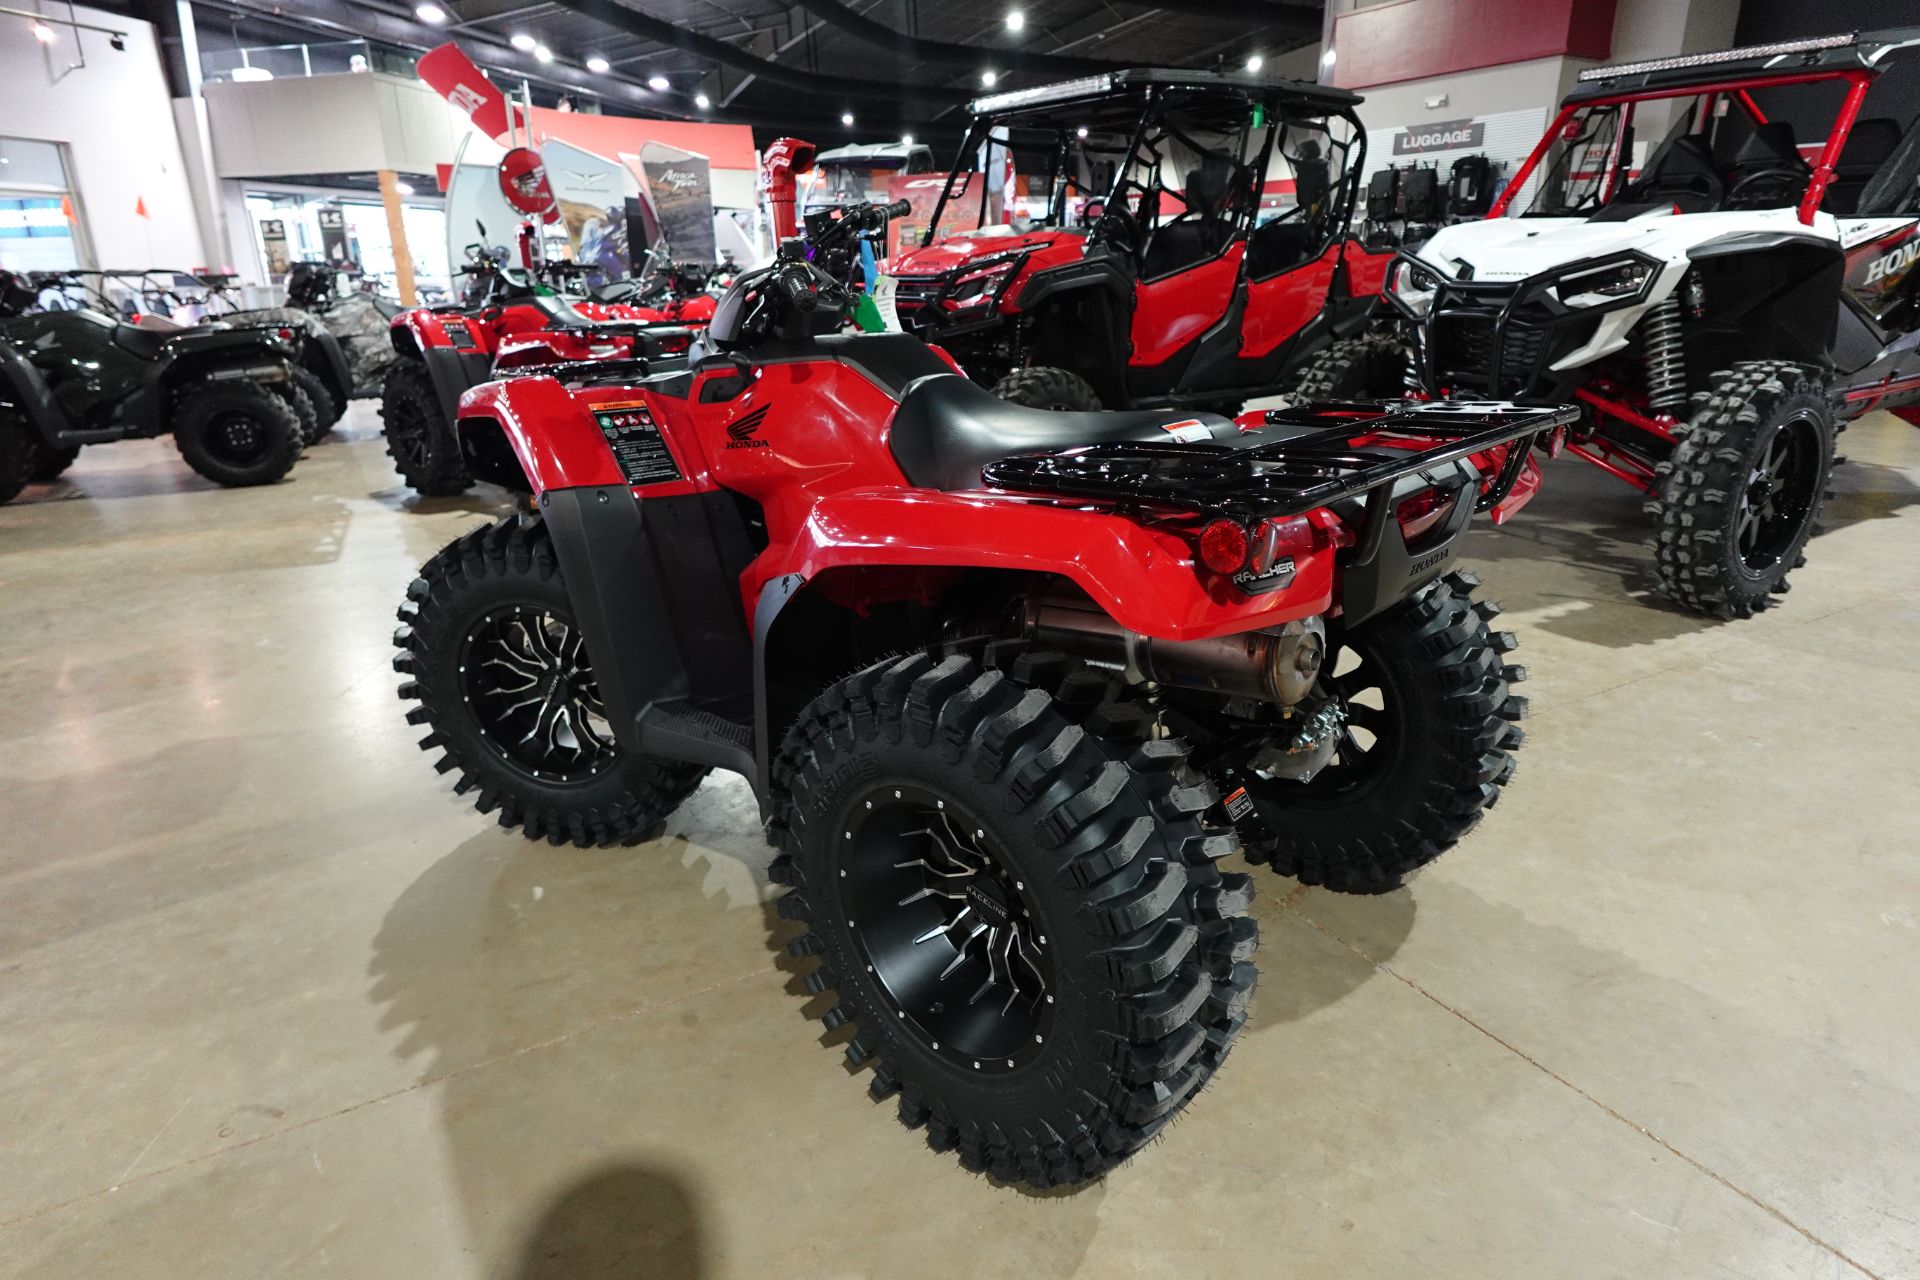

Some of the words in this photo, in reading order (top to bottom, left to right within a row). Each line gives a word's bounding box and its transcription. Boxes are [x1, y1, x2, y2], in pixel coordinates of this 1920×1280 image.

[1402, 129, 1472, 149] LUGGAGE
[658, 168, 696, 183] Africa
[672, 179, 699, 193] Twin
[726, 439, 770, 450] HONDA
[1408, 548, 1449, 577] HONDA
[966, 885, 1007, 919] RACELINE
